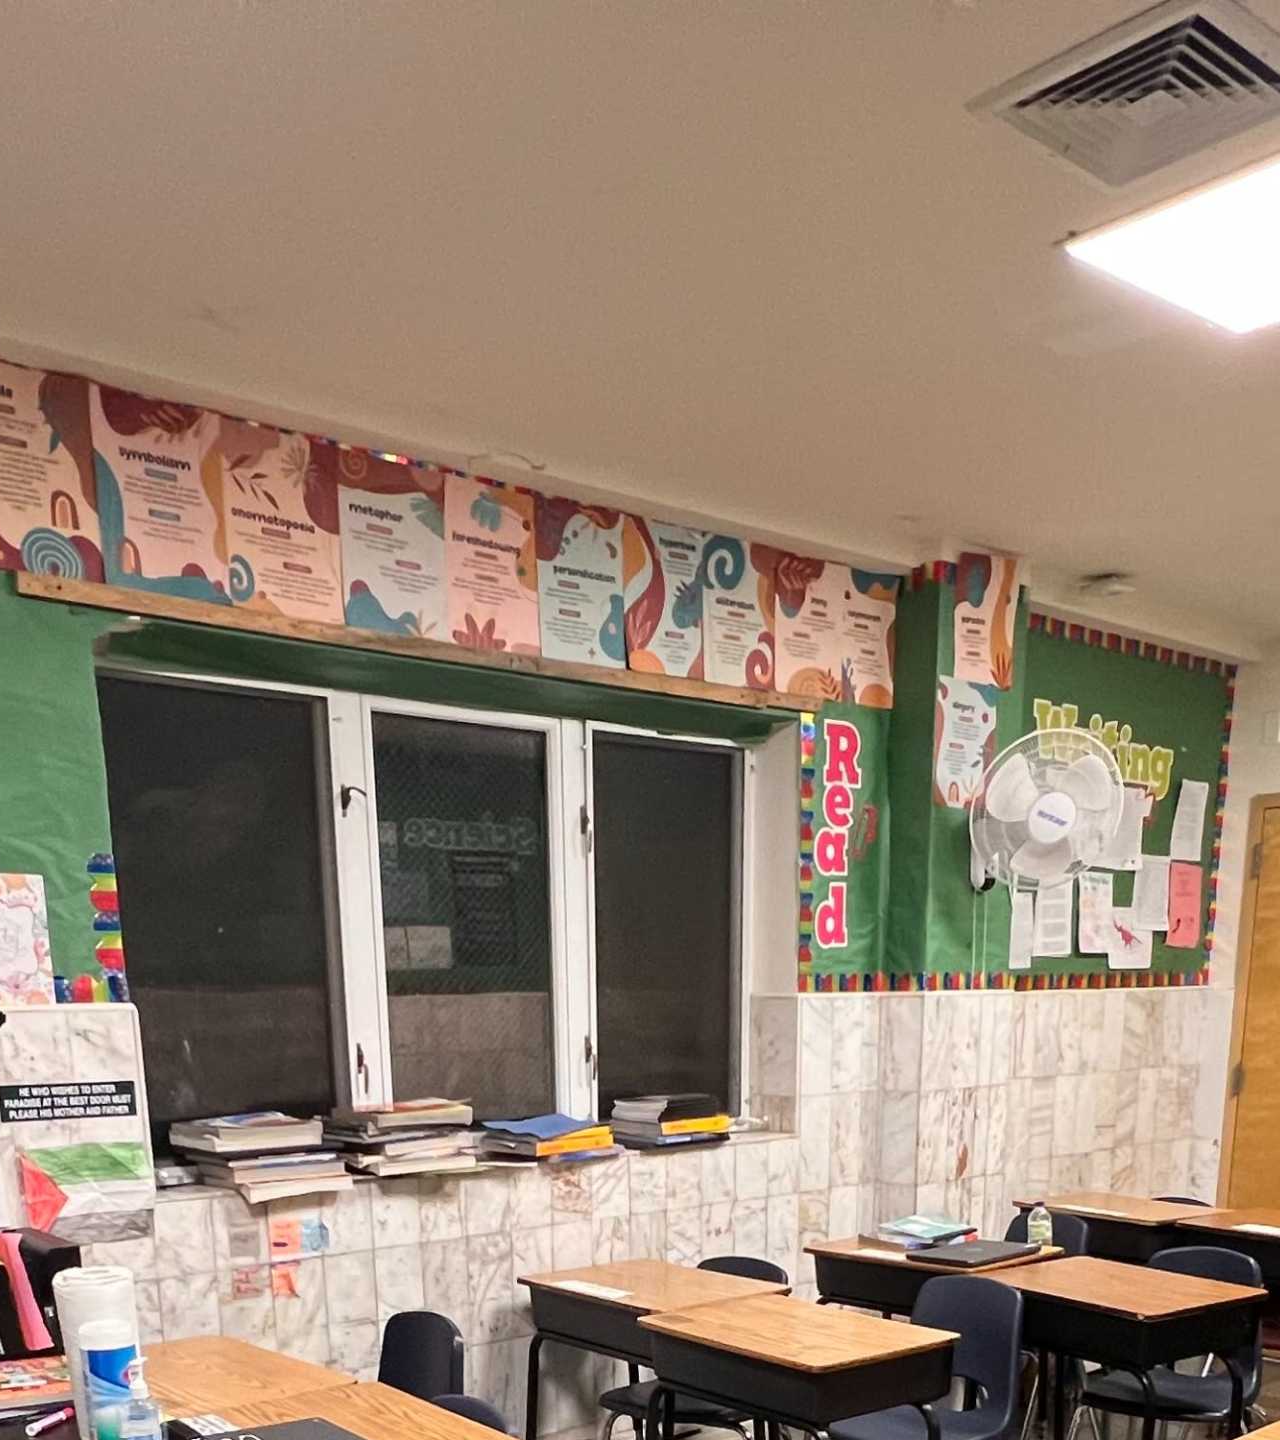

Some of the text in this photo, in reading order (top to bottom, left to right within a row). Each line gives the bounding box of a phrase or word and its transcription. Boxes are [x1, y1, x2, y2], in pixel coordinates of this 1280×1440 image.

[118, 446, 191, 472] symbolism
[348, 501, 403, 523] metaphor
[815, 719, 862, 948] Read
[80, 1085, 91, 1094] TO
[8, 1109, 39, 1119] PLEASE
